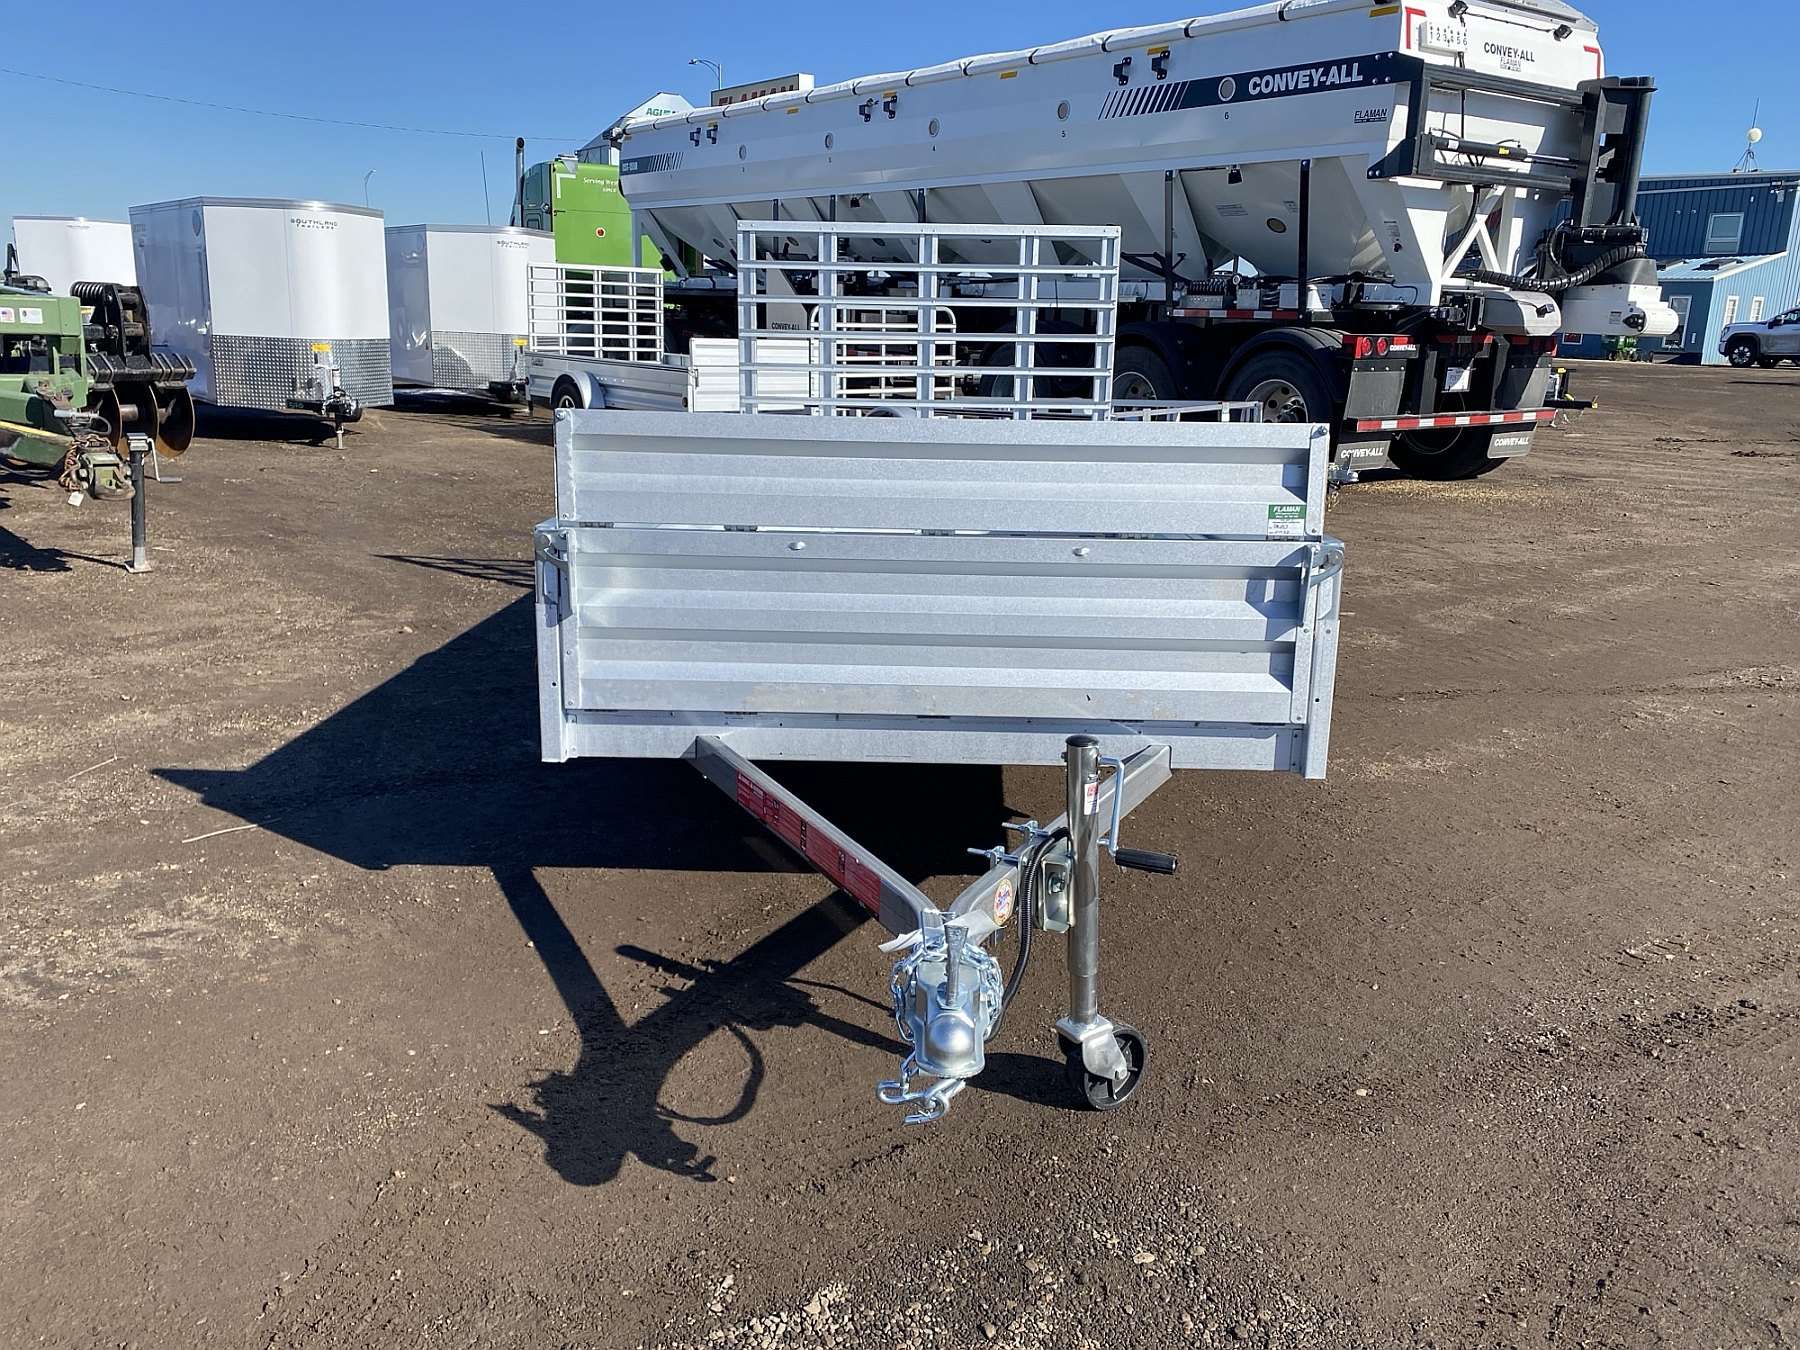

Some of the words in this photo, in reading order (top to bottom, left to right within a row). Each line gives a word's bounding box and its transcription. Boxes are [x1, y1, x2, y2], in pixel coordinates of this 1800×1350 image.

[1484, 42, 1536, 63] CONVEY-ALL
[1248, 62, 1363, 96] CONVEY-ALL
[1225, 111, 1230, 120] 6
[1354, 108, 1388, 119] FLAMAN
